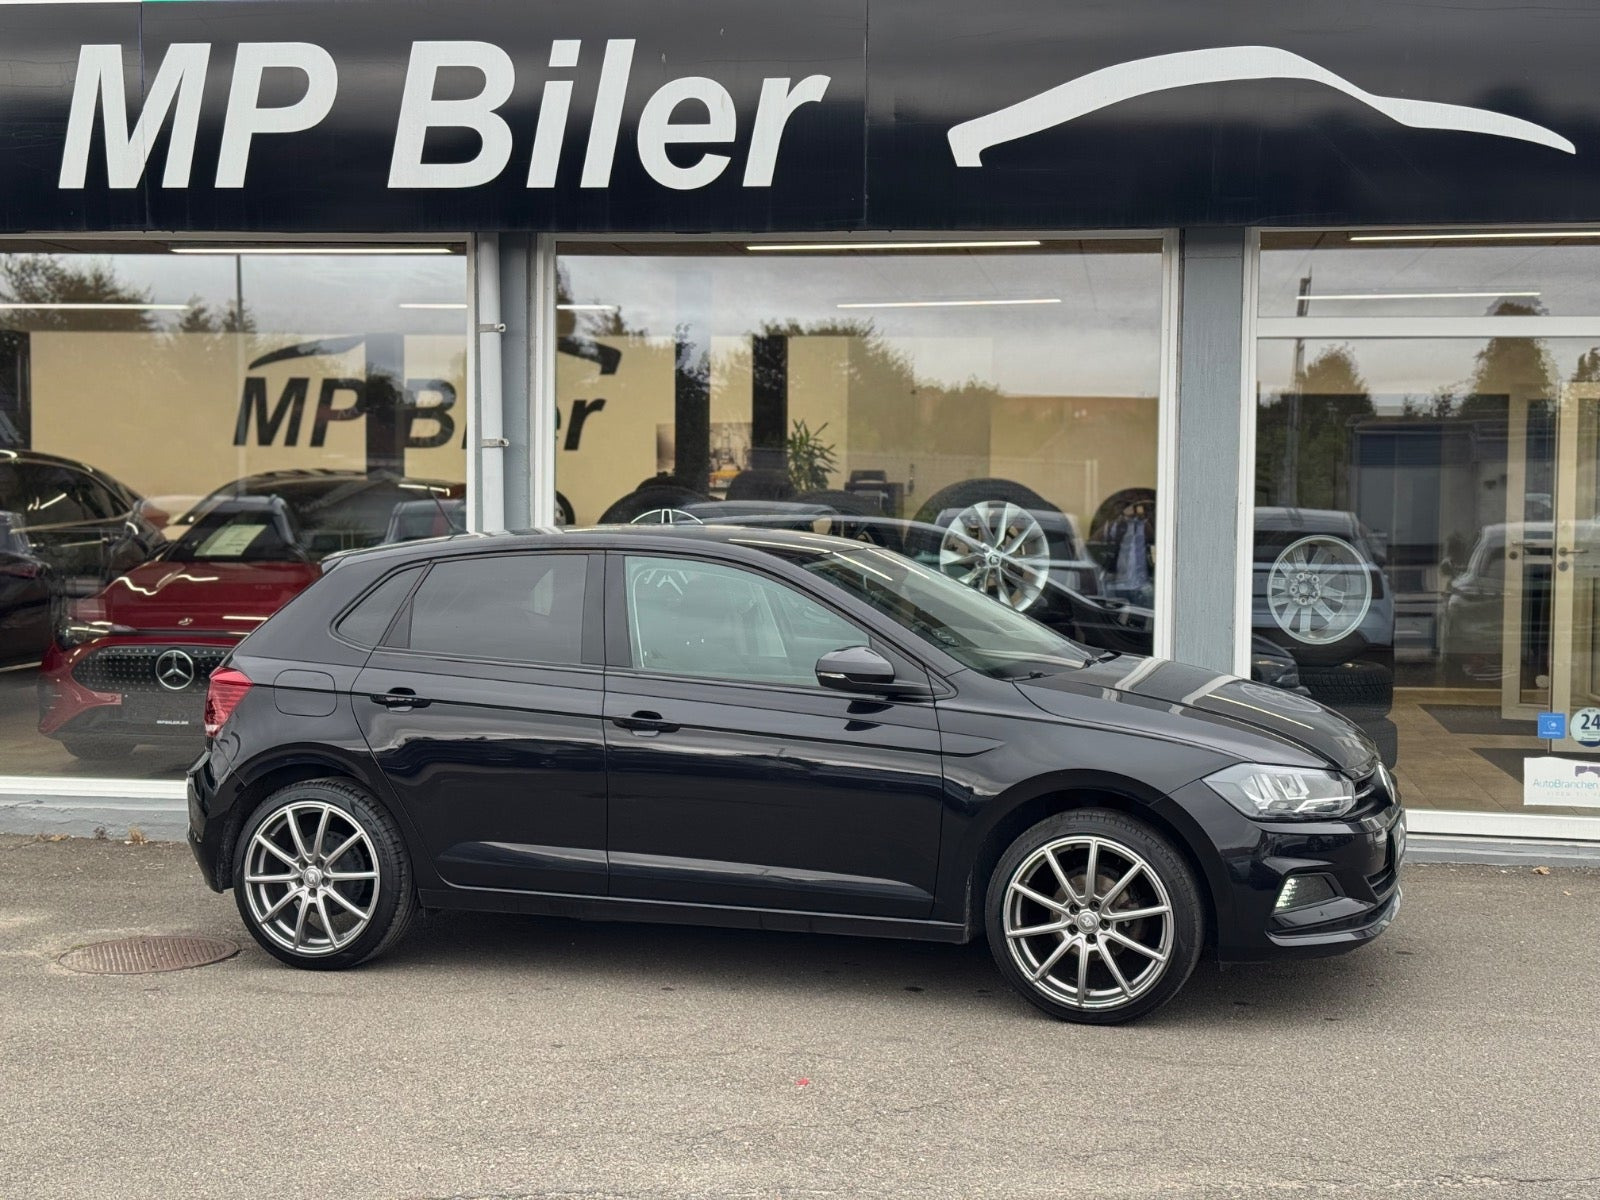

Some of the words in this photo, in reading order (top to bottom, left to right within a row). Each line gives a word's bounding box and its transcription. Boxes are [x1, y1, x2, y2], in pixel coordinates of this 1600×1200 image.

[58, 42, 339, 189] MP
[387, 39, 832, 190] Biler
[233, 377, 366, 447] MP
